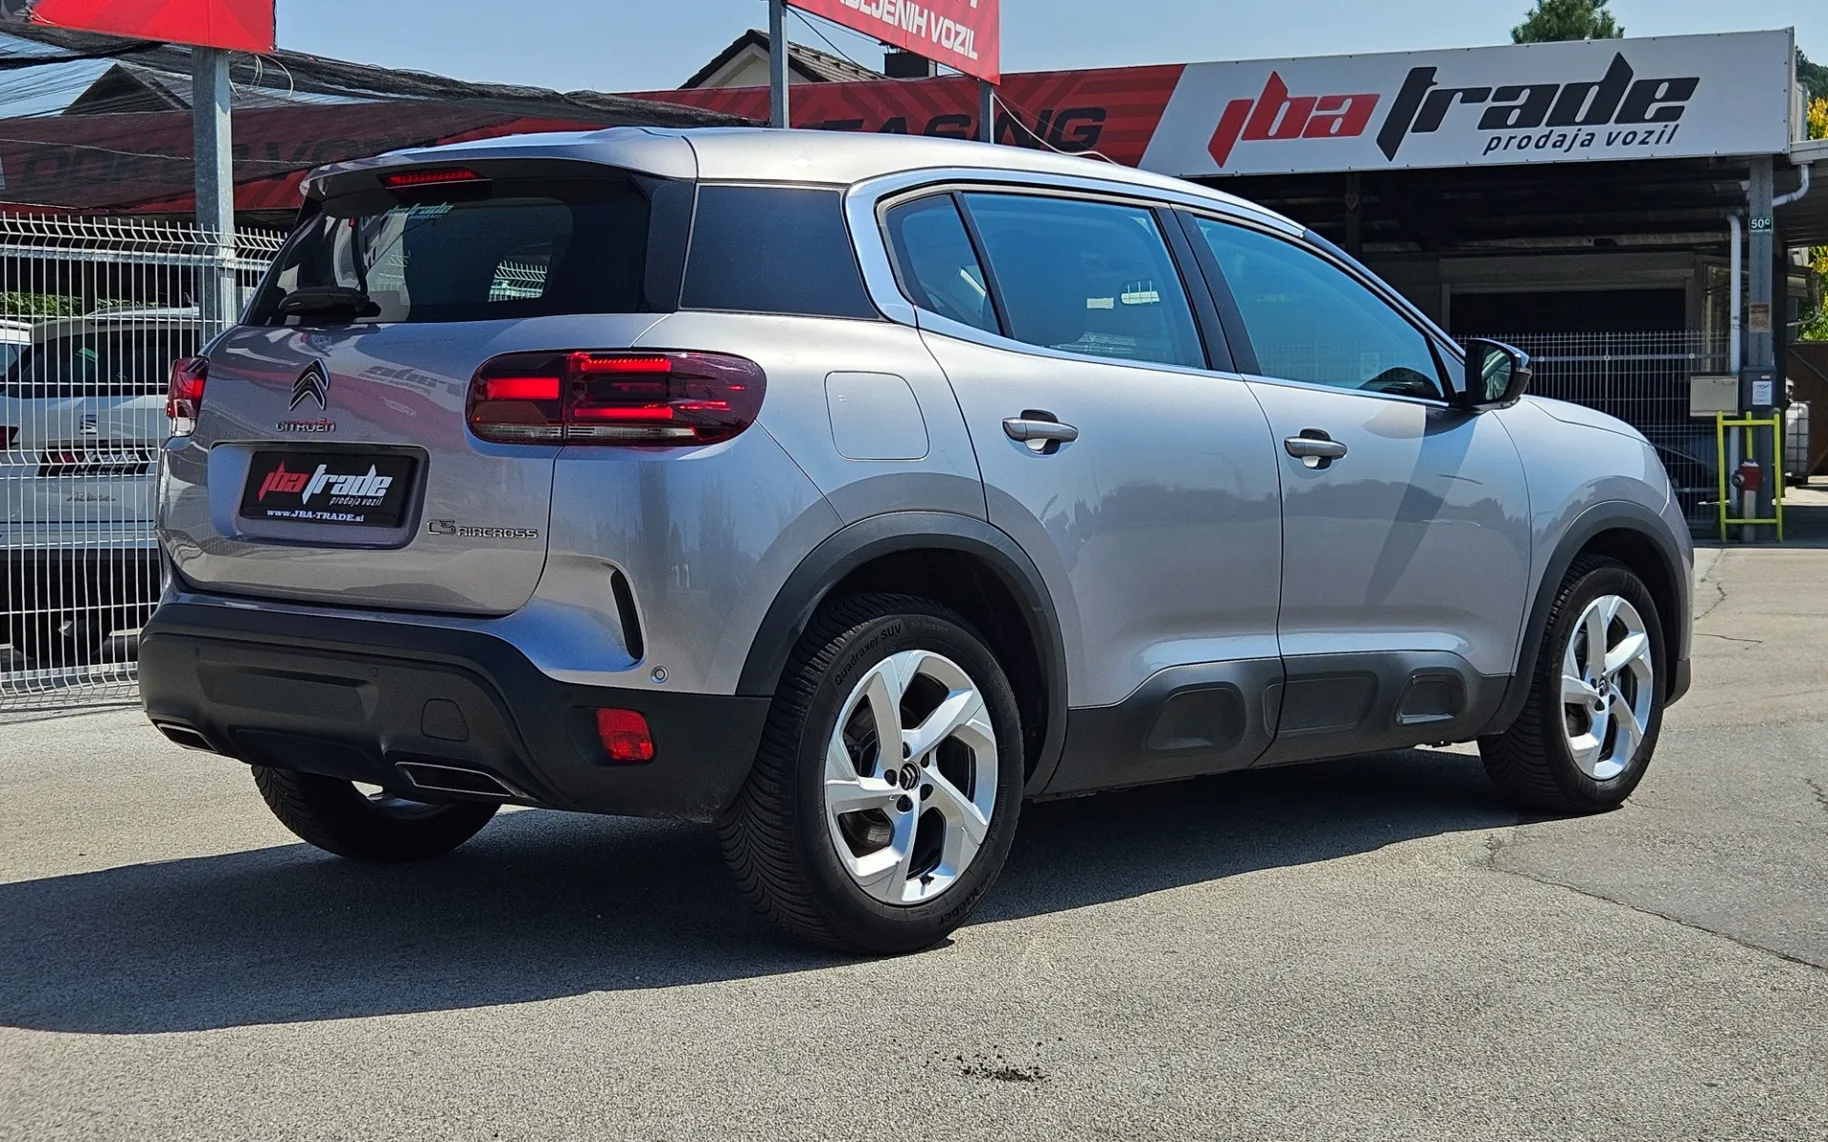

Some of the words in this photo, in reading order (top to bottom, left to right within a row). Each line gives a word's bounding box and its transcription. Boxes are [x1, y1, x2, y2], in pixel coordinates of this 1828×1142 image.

[930, 11, 978, 60] VOZIL
[1376, 51, 1700, 162] trade
[1482, 128, 1596, 156] prodaja
[1605, 124, 1679, 147] vozil
[302, 463, 393, 506] trade
[328, 495, 361, 508] prodaja
[361, 496, 384, 507] vozil
[426, 519, 456, 535] C5
[457, 526, 539, 539] AIRCROSS
[834, 635, 881, 687] Quadraxer
[880, 622, 902, 640] SUV
